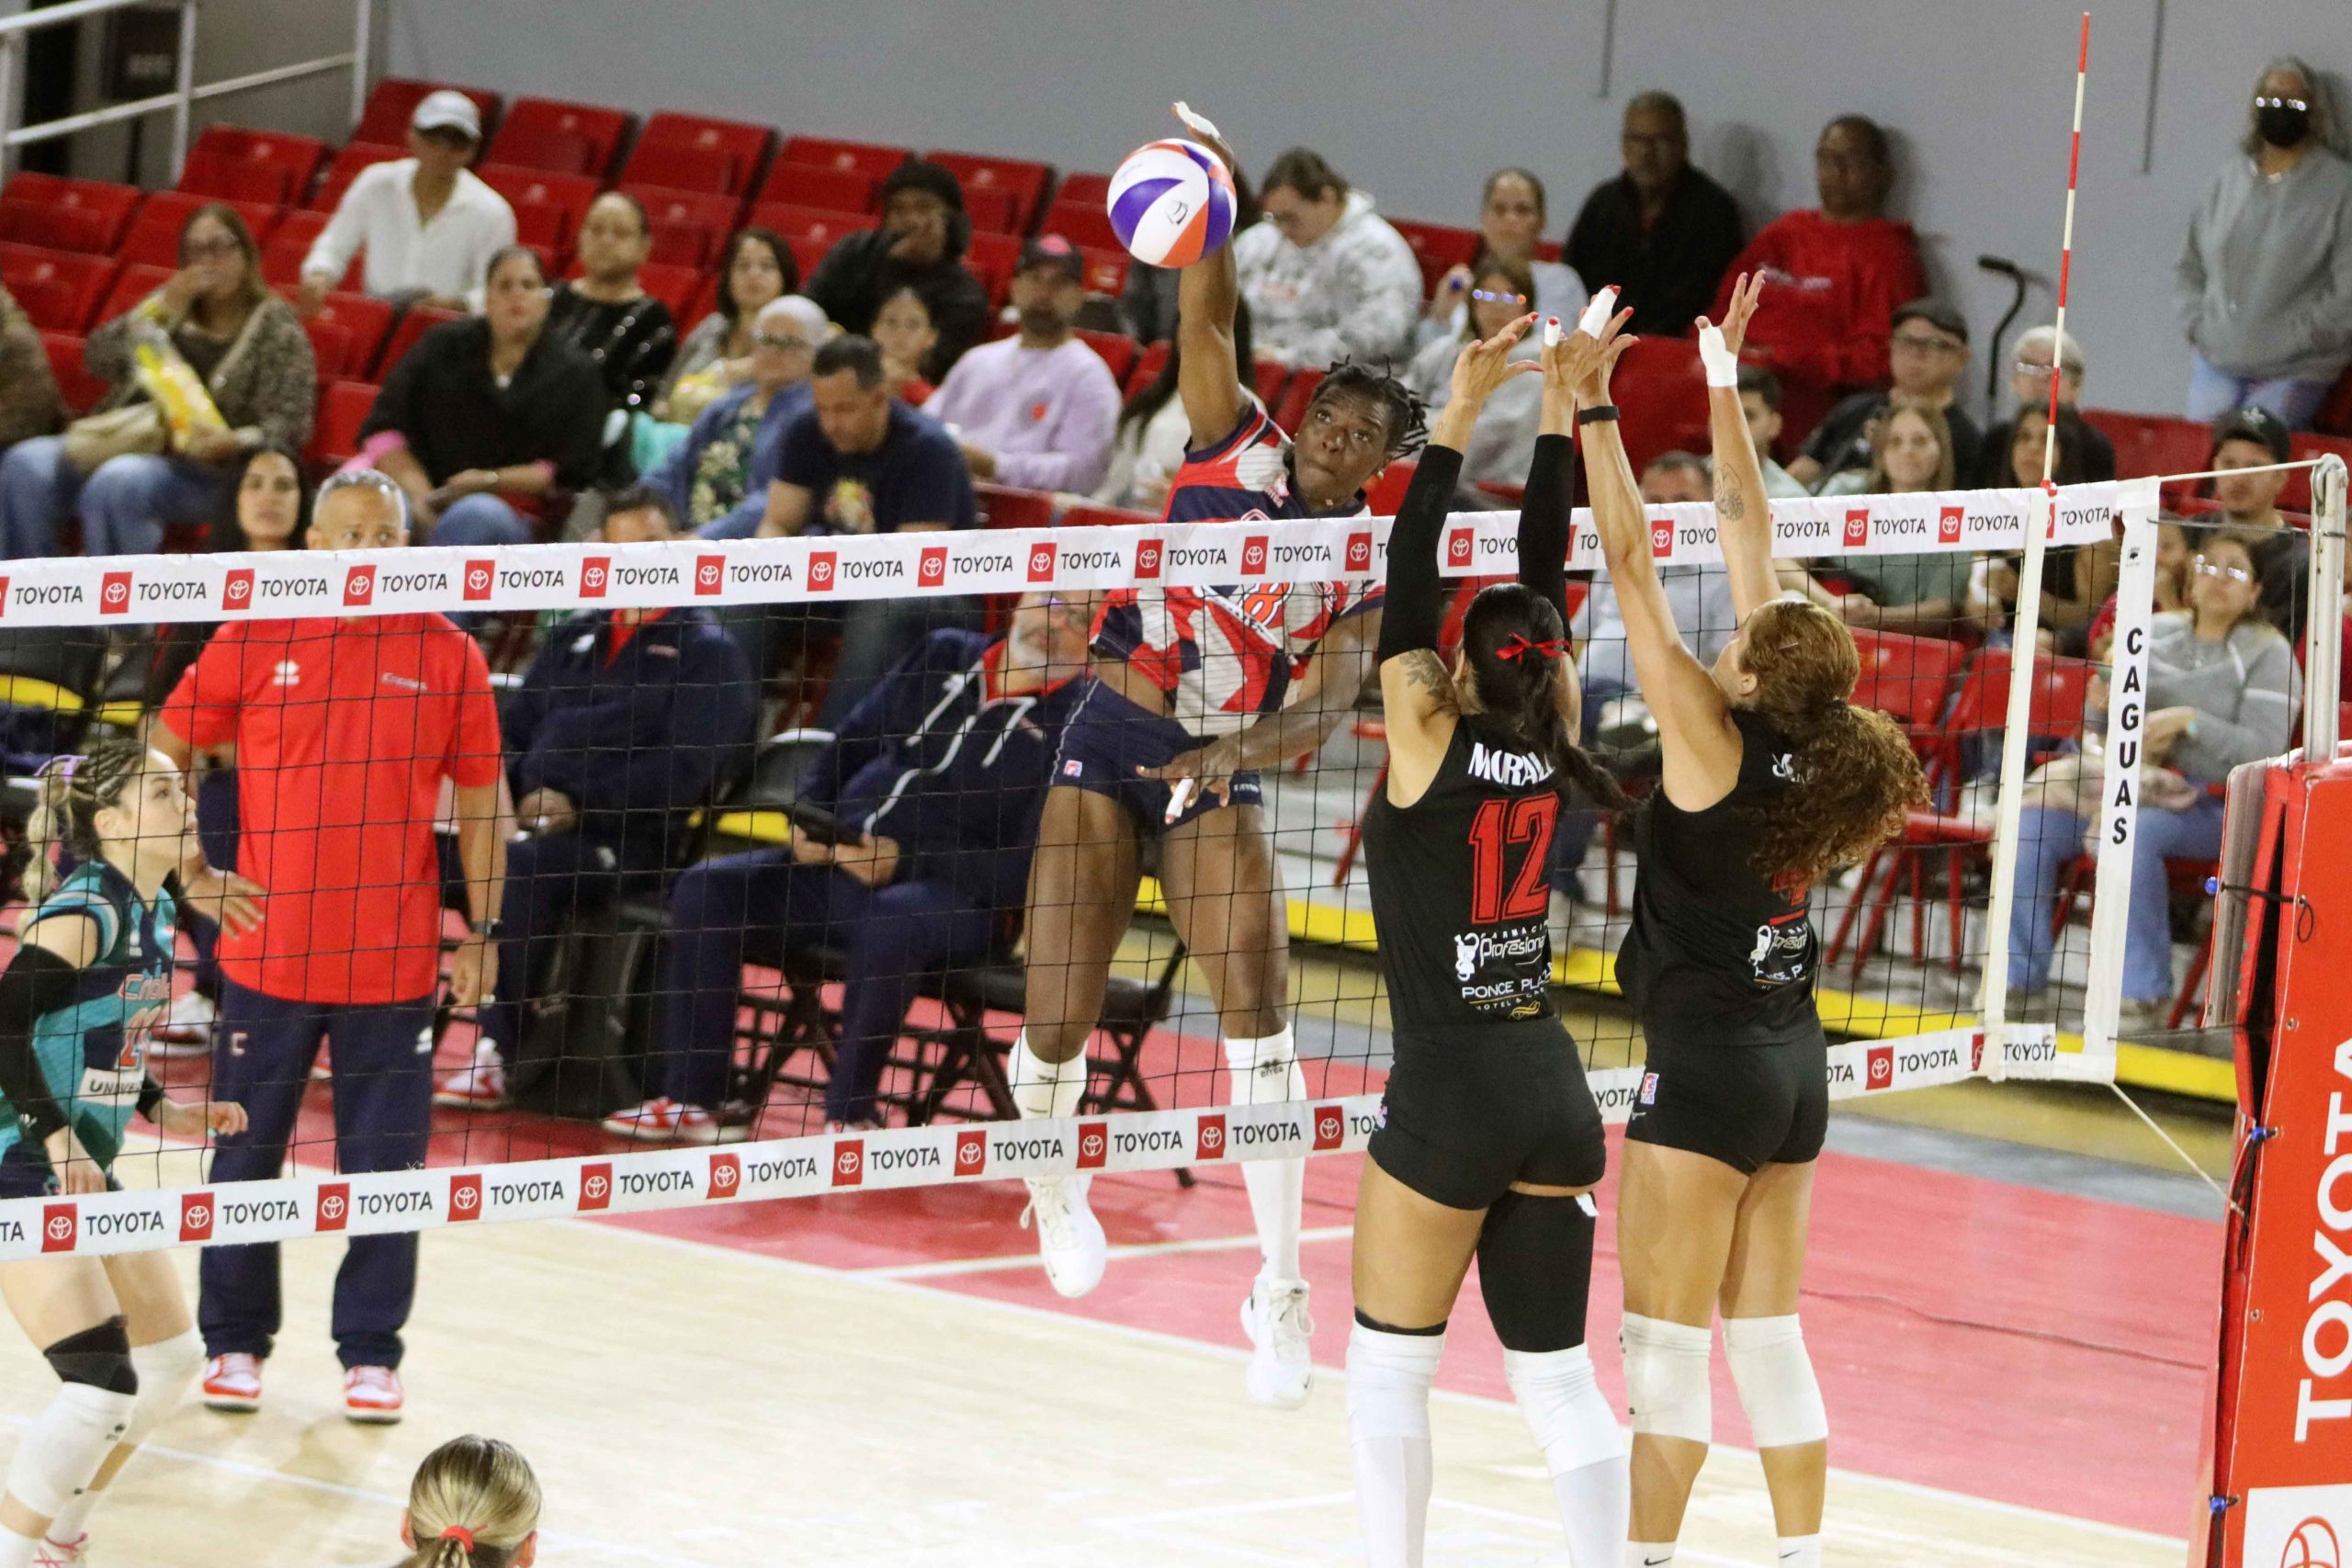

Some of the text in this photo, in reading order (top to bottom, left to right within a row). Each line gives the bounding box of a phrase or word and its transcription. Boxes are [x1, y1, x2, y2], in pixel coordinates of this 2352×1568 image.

[15, 506, 2109, 605] TOYOTA TOYOTA TOYOTA TOYOTA TOYOTA TOYOTA TOYOTA TOYOTA TOYOTA TOYOTA TOYOTA TOYOTA TOYO TOYO TOYOTA TOYOTA TOYOTA TOYOTA
[1467, 741, 1555, 786] MORAL
[2112, 627, 2143, 844] CAGUAS
[1468, 790, 1559, 924] 12
[1479, 935, 1546, 967] Profesiona
[1462, 980, 1514, 998] PONCE
[1476, 999, 1511, 1010] HOTEL
[85, 1210, 164, 1236] TOYOTA
[222, 1200, 300, 1224] TOYOTA
[357, 1190, 433, 1215] TOYOTA
[490, 1180, 564, 1206] TOYOTA
[619, 1170, 695, 1194] TOYOTA
[747, 1156, 818, 1183] TOYOTA
[870, 1146, 941, 1170] TOYOTA
[992, 1138, 1064, 1162] TOYOTA
[1114, 1130, 1183, 1154] TOYOTA
[1232, 1122, 1302, 1145] TOYOTA
[1595, 1087, 1636, 1109] YOTA
[1826, 1063, 1855, 1085] OTA
[1898, 1048, 1959, 1074] TOYOTA
